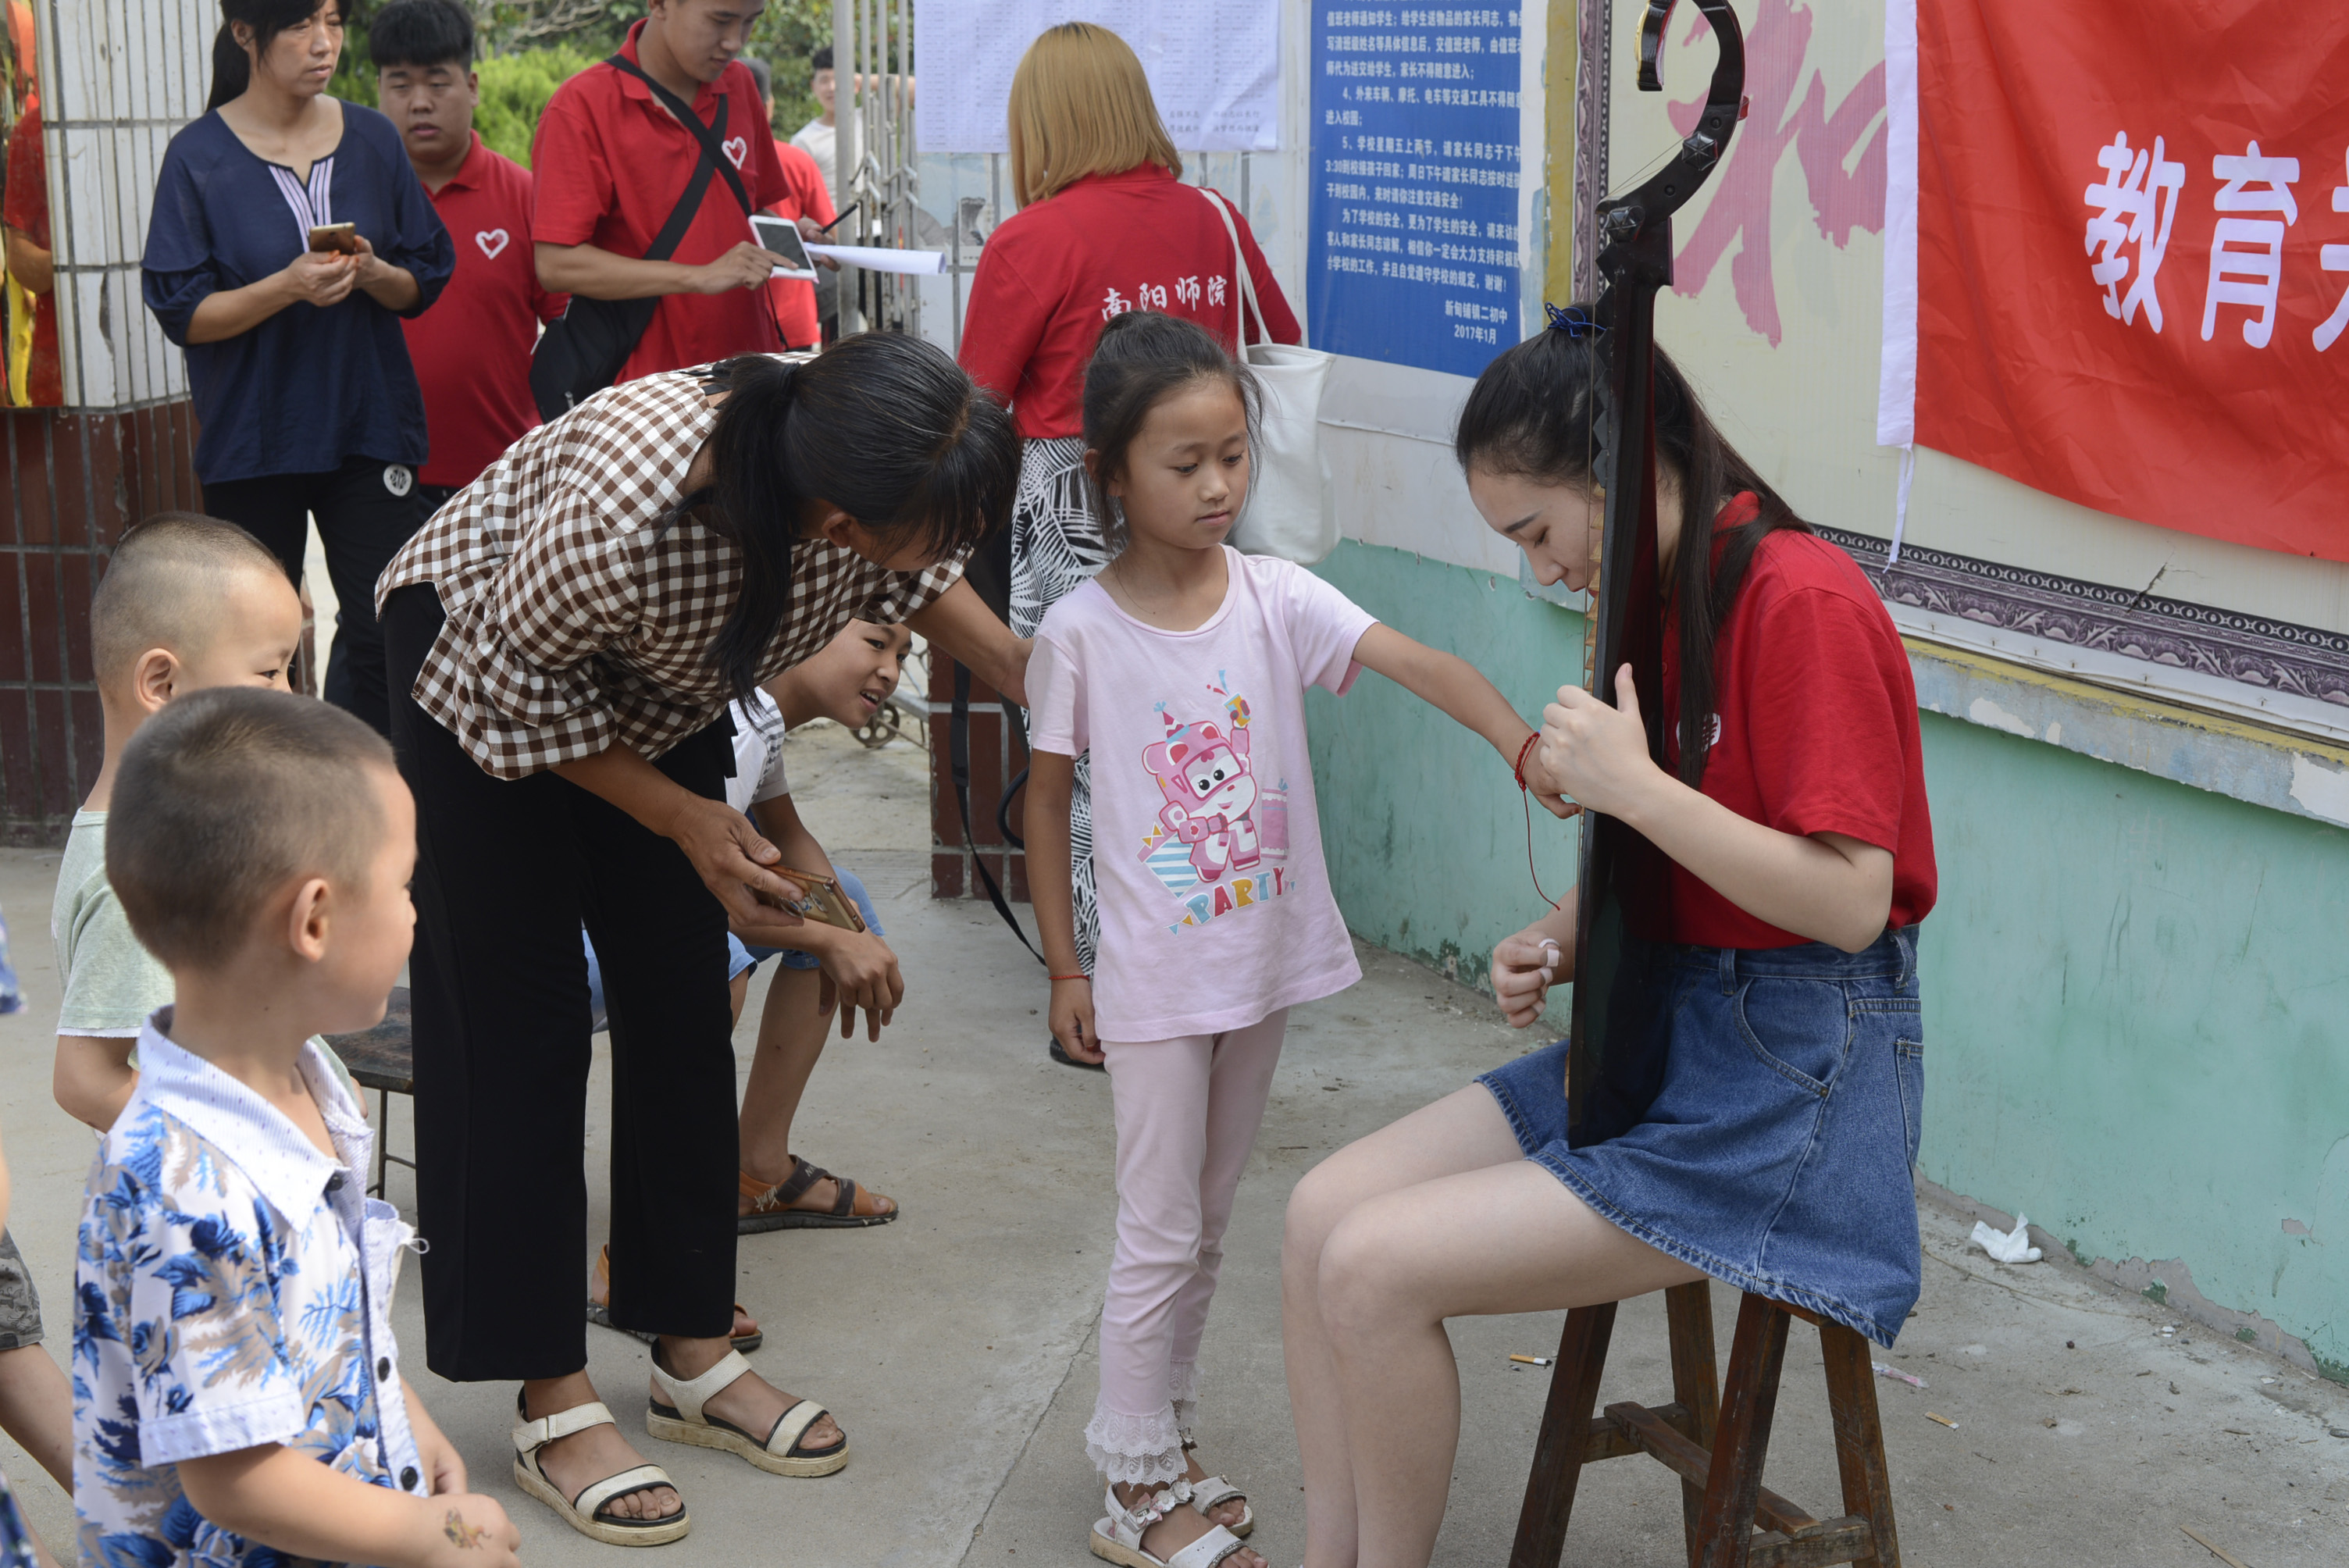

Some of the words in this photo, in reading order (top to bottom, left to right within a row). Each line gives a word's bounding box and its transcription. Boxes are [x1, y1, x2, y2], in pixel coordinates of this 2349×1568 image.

[1325, 109, 1363, 127] 进入校园；
[1101, 275, 1228, 322] 南阳师院
[1445, 300, 1508, 324] 新甸铺镇二初中
[1454, 324, 1497, 345] 2017年1月
[1185, 866, 1285, 925] PARTY
